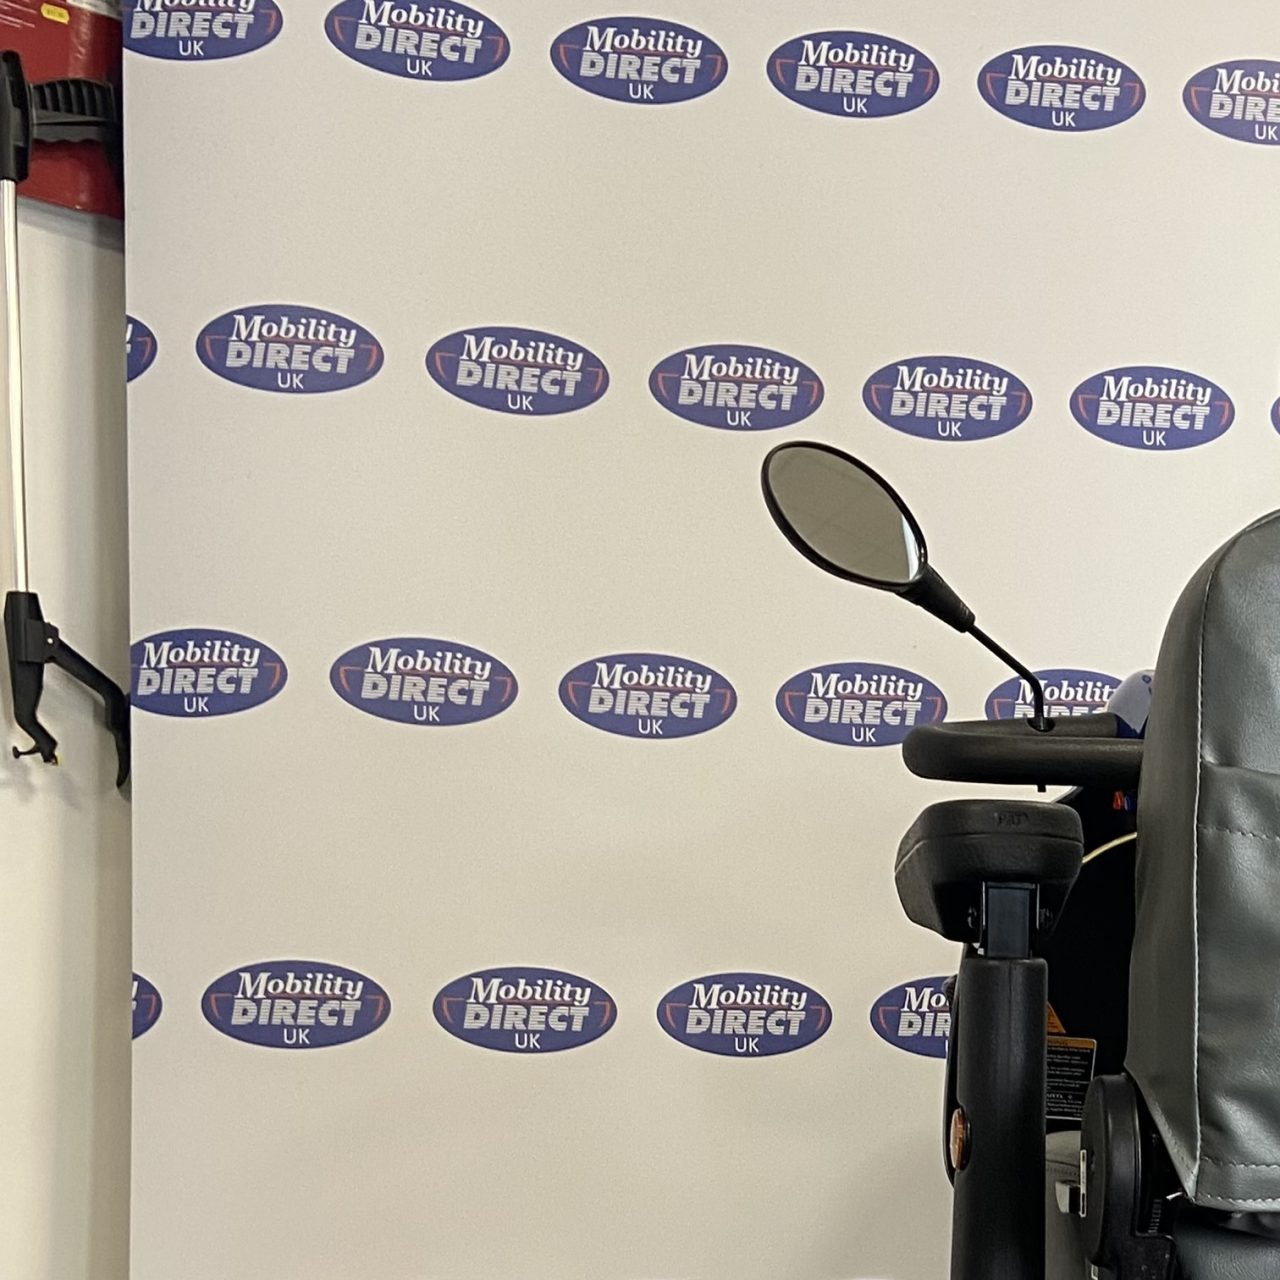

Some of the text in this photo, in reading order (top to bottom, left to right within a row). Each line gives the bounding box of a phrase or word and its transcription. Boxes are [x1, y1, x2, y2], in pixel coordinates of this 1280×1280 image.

[132, 10, 255, 40] DIRECT
[359, 2, 484, 39] Mobility
[180, 42, 204, 56] UK
[356, 26, 483, 64] DIRECT
[584, 27, 703, 59] Mobility
[408, 60, 433, 77] UK
[581, 53, 702, 84] DIRECT
[800, 42, 916, 73] Mobility
[1008, 54, 1122, 87] Mobility
[630, 84, 654, 100] UK
[796, 67, 915, 98] DIRECT
[1004, 80, 1121, 112] DIRECT
[845, 98, 868, 114] UK
[1051, 110, 1077, 128] UK
[1254, 124, 1278, 141] UK
[230, 316, 357, 349] Mobility
[227, 343, 356, 374] DIRECT
[460, 337, 584, 372] Mobility
[279, 373, 304, 390] UK
[457, 361, 583, 397] DIRECT
[682, 356, 796, 386] Mobility
[894, 367, 1009, 397] Mobility
[509, 395, 534, 411] UK
[679, 381, 796, 411] DIRECT
[1101, 377, 1211, 407] Mobility
[728, 411, 751, 426] UK
[892, 392, 1008, 422] DIRECT
[1098, 402, 1211, 431] DIRECT
[939, 422, 962, 437] UK
[1144, 431, 1167, 447] UK
[144, 642, 260, 668] Mobility
[365, 649, 491, 680] Mobility
[139, 667, 259, 695] DIRECT
[362, 675, 491, 706] DIRECT
[593, 665, 712, 695] Mobility
[808, 674, 923, 702] Mobility
[185, 698, 209, 713] UK
[415, 706, 440, 721] UK
[589, 689, 711, 719] DIRECT
[805, 699, 923, 727] DIRECT
[640, 720, 663, 734] UK
[853, 728, 877, 743] UK
[236, 973, 362, 1001] Mobility
[467, 979, 591, 1007] Mobility
[690, 985, 806, 1011] Mobility
[232, 1000, 362, 1027] DIRECT
[465, 1005, 590, 1032] DIRECT
[687, 1010, 806, 1036] DIRECT
[285, 1030, 310, 1044] UK
[516, 1034, 541, 1048] UK
[736, 1039, 760, 1053] UK
